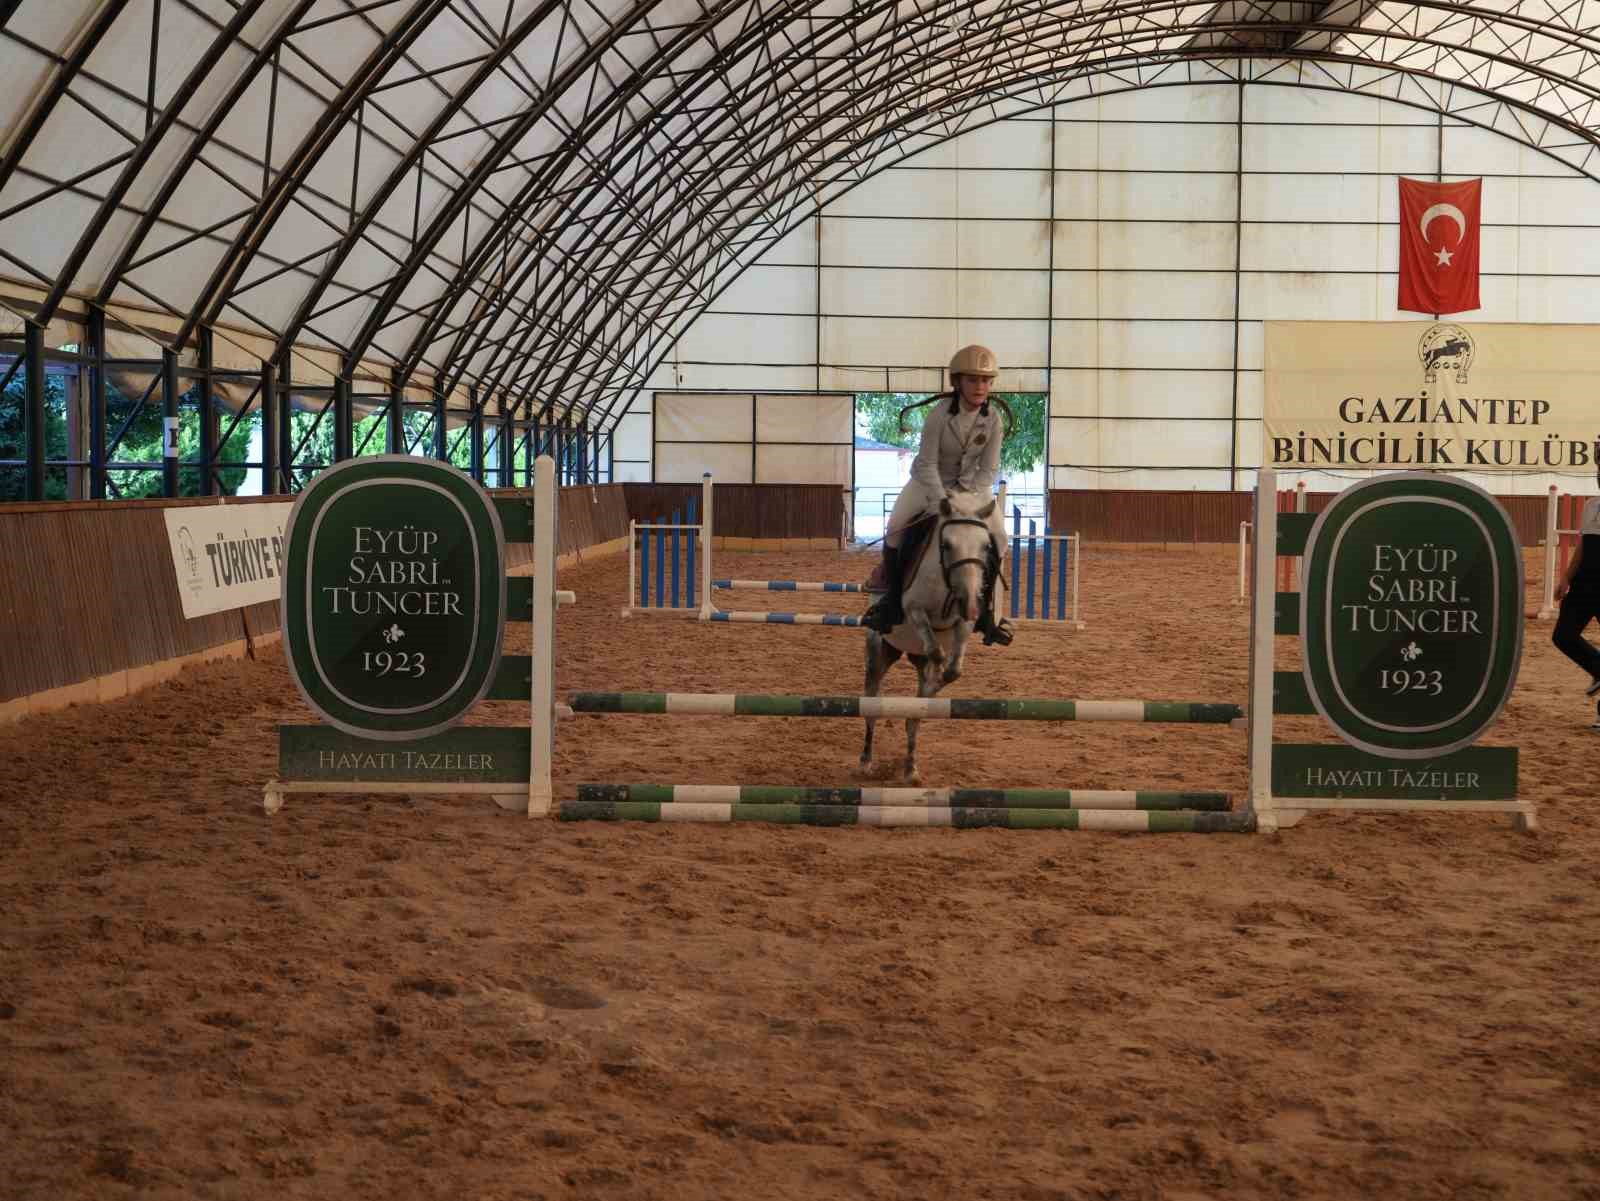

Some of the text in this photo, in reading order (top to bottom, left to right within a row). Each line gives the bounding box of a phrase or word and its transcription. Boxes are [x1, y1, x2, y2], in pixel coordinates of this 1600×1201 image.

[1338, 390, 1550, 425] GAZİANTEP
[1271, 430, 1453, 464] BİNİCİLİK
[352, 524, 438, 554] EYÜP
[205, 528, 273, 588] TÜRKİYE
[349, 556, 440, 585] SABRİ
[1374, 543, 1457, 572] EYÜP
[322, 587, 464, 616] TUNCER
[1367, 575, 1457, 603] SABRİ
[1341, 605, 1483, 634] TUNCER
[362, 651, 426, 678] 1923
[1380, 669, 1443, 696] 1923
[319, 750, 495, 770] HAYATI TAZELER
[1306, 767, 1480, 788] HAYATI TAZELER
